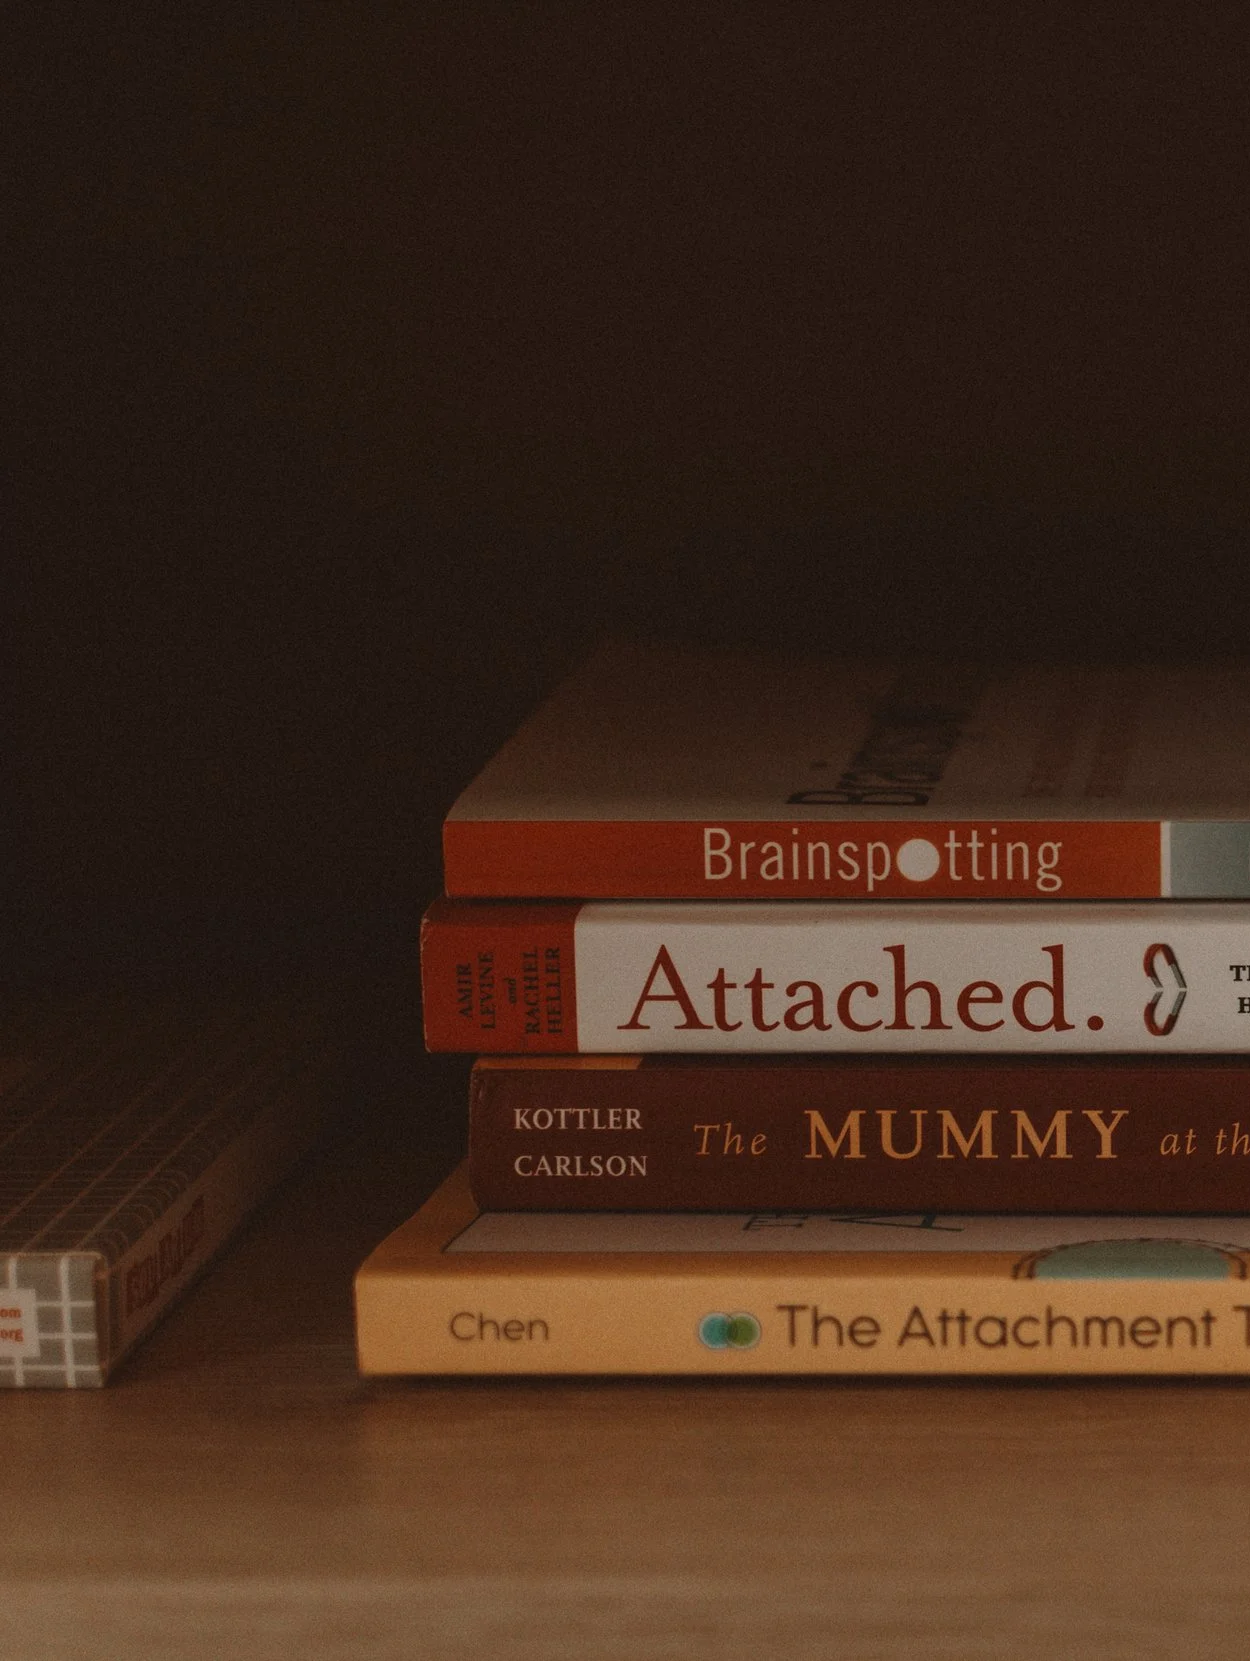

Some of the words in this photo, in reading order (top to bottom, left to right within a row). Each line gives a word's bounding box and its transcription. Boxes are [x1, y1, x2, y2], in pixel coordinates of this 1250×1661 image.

[704, 827, 1063, 892] Brainspotting
[456, 963, 473, 1018] AMIR
[479, 952, 496, 1029] LEVINE
[523, 947, 541, 1034] RACHEL
[545, 947, 562, 1034] HELLER
[617, 943, 1105, 1033] Attached.
[513, 1108, 643, 1130] KOTTLER
[693, 1122, 767, 1156] The
[804, 1109, 1130, 1159] MUMMY
[1159, 1127, 1197, 1156] at
[513, 1155, 648, 1177] CARLSON
[448, 1311, 550, 1343] Chen
[776, 1305, 882, 1349] The
[897, 1306, 1217, 1349] Attachment
